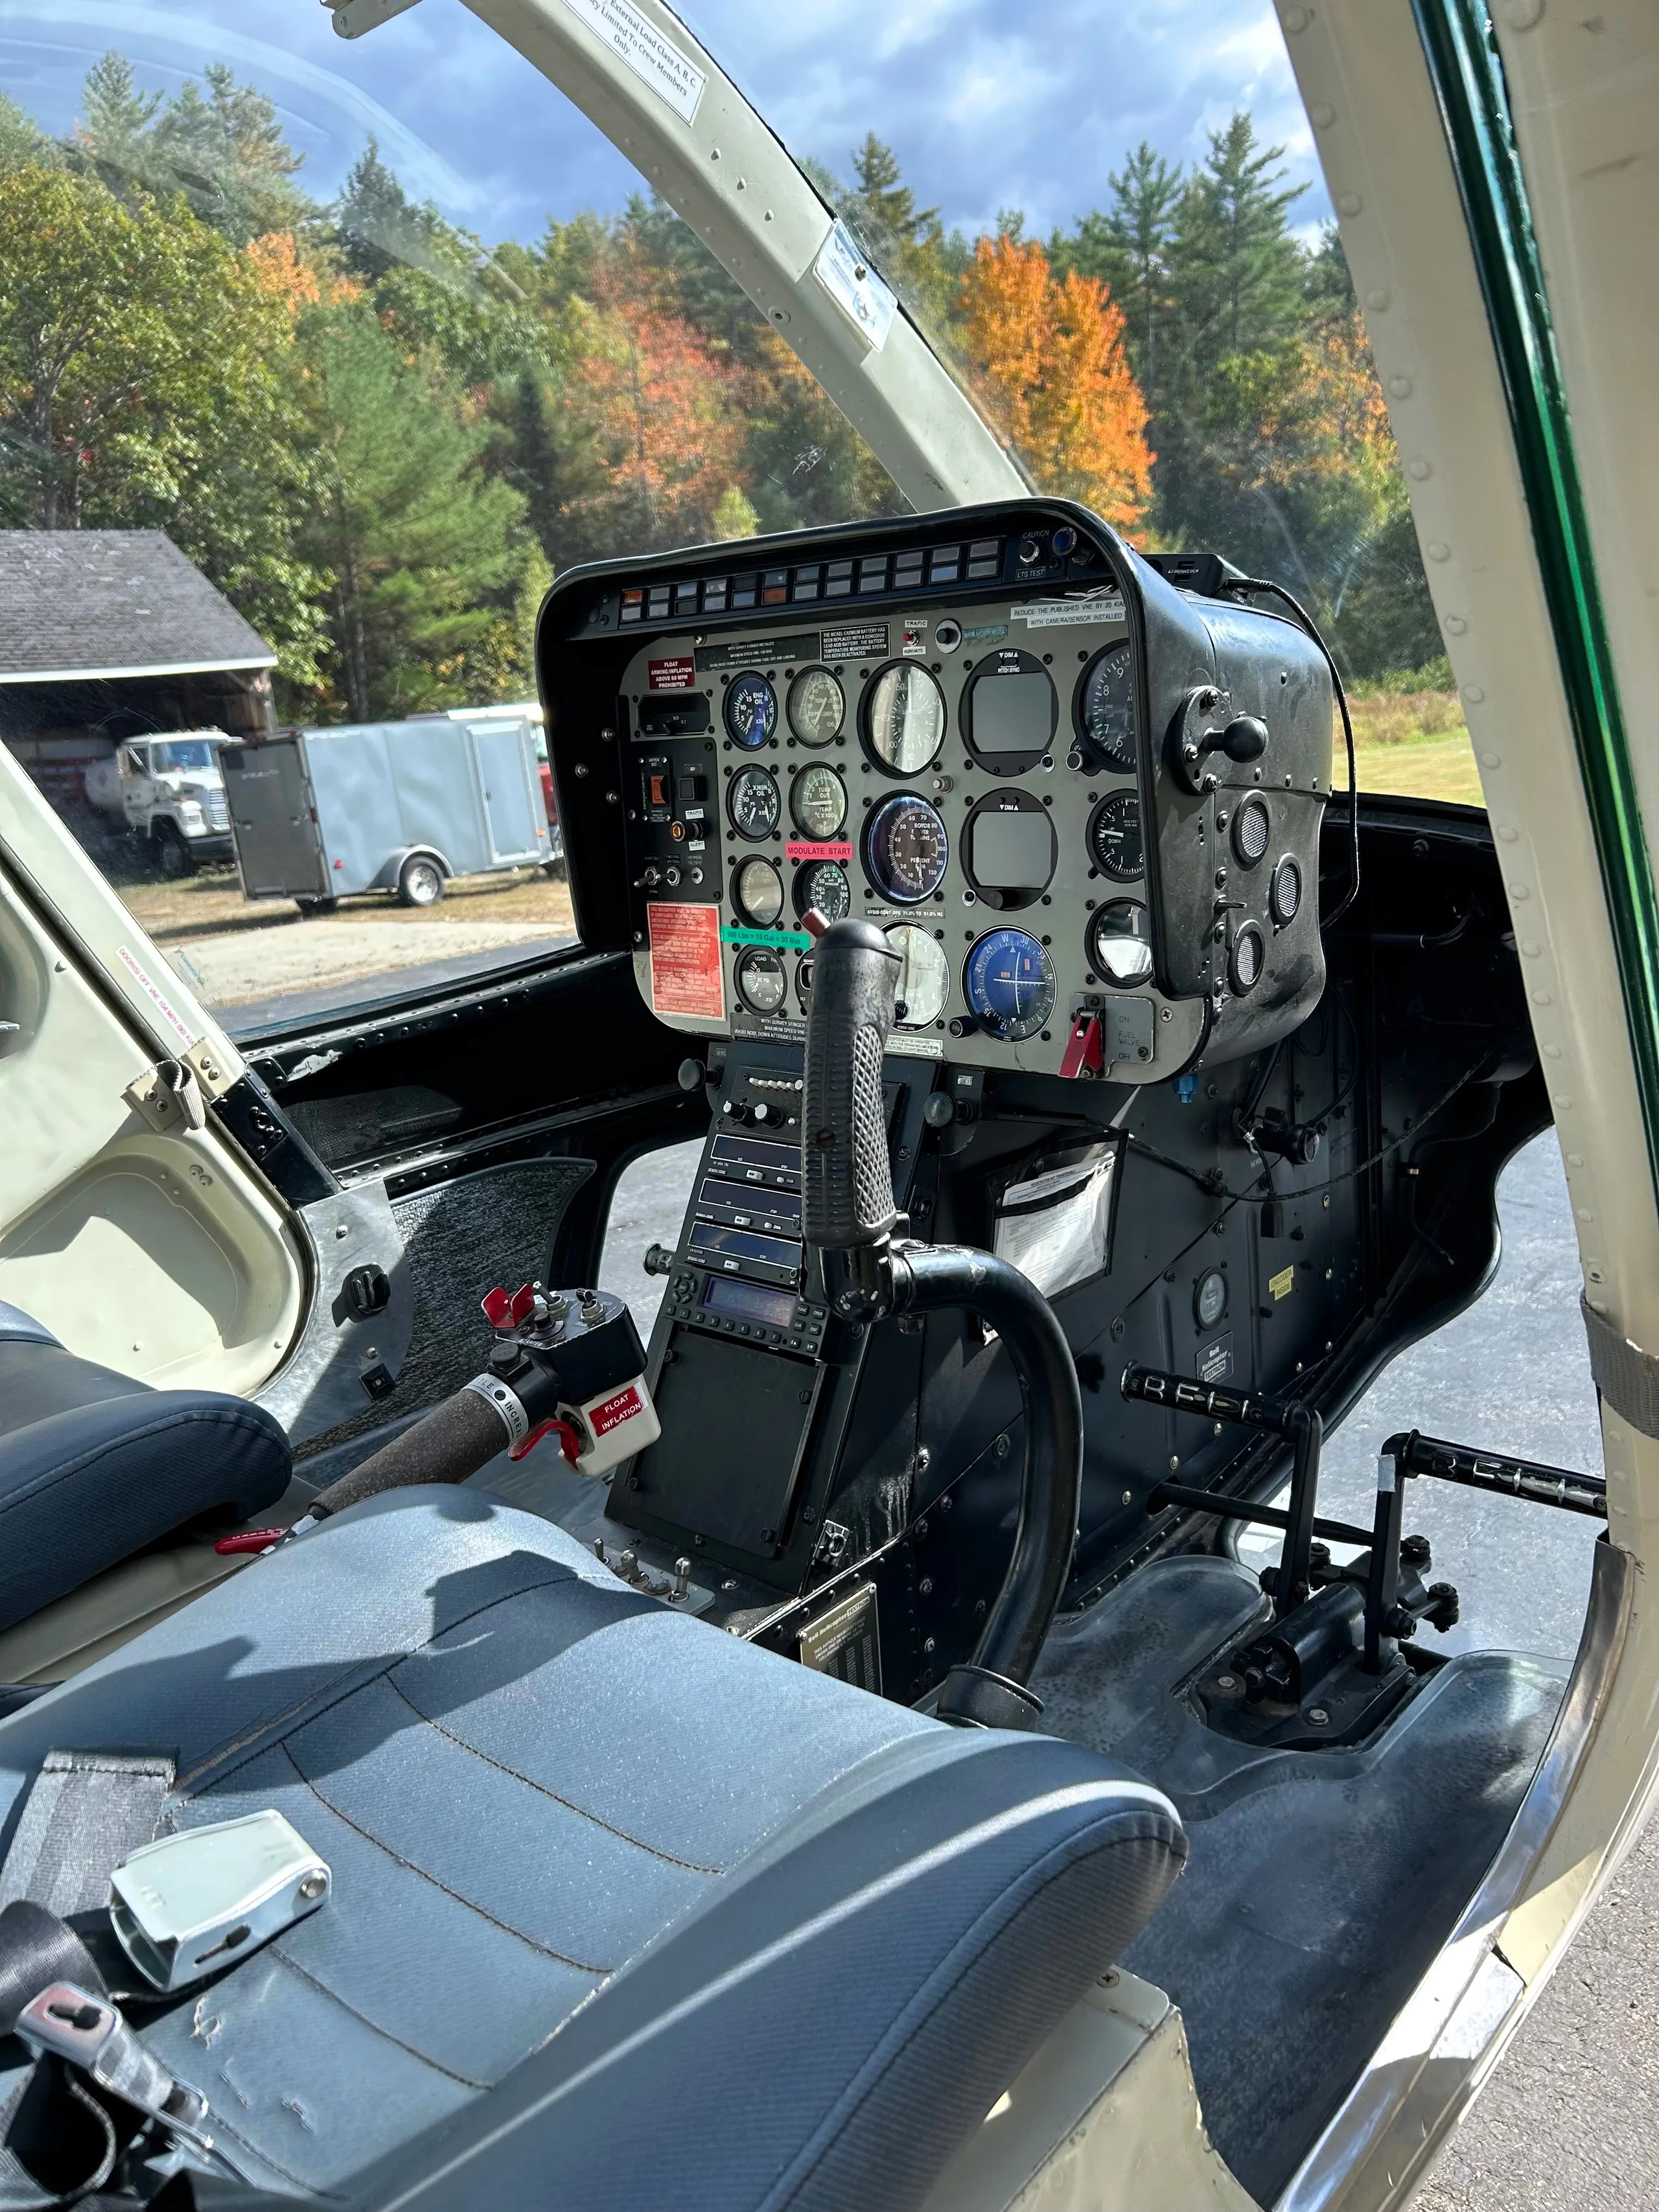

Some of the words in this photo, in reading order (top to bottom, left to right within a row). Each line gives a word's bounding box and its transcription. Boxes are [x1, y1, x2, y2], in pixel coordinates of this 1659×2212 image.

[610, 0, 639, 30] External
[640, 27, 656, 48] Load
[657, 45, 674, 65] Class
[674, 64, 681, 73] A,
[682, 69, 688, 82] B,
[614, 34, 631, 57] Only.
[601, 6, 627, 38] Limited
[629, 32, 638, 47] To
[638, 43, 656, 64] Crew
[656, 61, 687, 96] Members
[1023, 530, 1050, 539] CAUTION
[1014, 607, 1036, 616] REDUCE
[1050, 603, 1079, 612] PUBLISHED
[1045, 615, 1091, 625] CAMERA/SENSOR
[1093, 612, 1122, 622] INSTALLED
[1117, 667, 1124, 679] 9
[916, 679, 924, 688] 20
[1103, 685, 1109, 696] 8
[1103, 724, 1109, 734] 7
[1116, 736, 1122, 747] 6
[906, 752, 914, 761] 80
[788, 846, 825, 855] MODULATE
[829, 847, 851, 856] START
[1001, 933, 1008, 942] W
[1021, 936, 1029, 945] 30
[984, 944, 993, 954] 24
[975, 963, 982, 973] 21
[119, 948, 140, 975] DOOR(S)
[139, 975, 150, 986] OFF
[149, 987, 160, 999] VNE
[167, 1010, 179, 1025] MPH
[1021, 1025, 1026, 1034] E
[1119, 1038, 1140, 1046] VALVE
[1271, 1269, 1292, 1289] ENCODER
[1276, 1282, 1290, 1296] INSIDE
[518, 1338, 543, 1347] STARTER
[1209, 1345, 1219, 1357] Bell
[1201, 1351, 1228, 1371] Helicopter
[1205, 1362, 1225, 1380] TEXTRON
[605, 1394, 629, 1414] FLOAT
[602, 1402, 642, 1430] INFLATION
[808, 1633, 819, 1643] Bell
[819, 1612, 847, 1636] Helicopter
[848, 1598, 870, 1616] TEXTRON
[842, 1631, 852, 1640] MORE
[822, 1636, 837, 1649] ARTICLE
